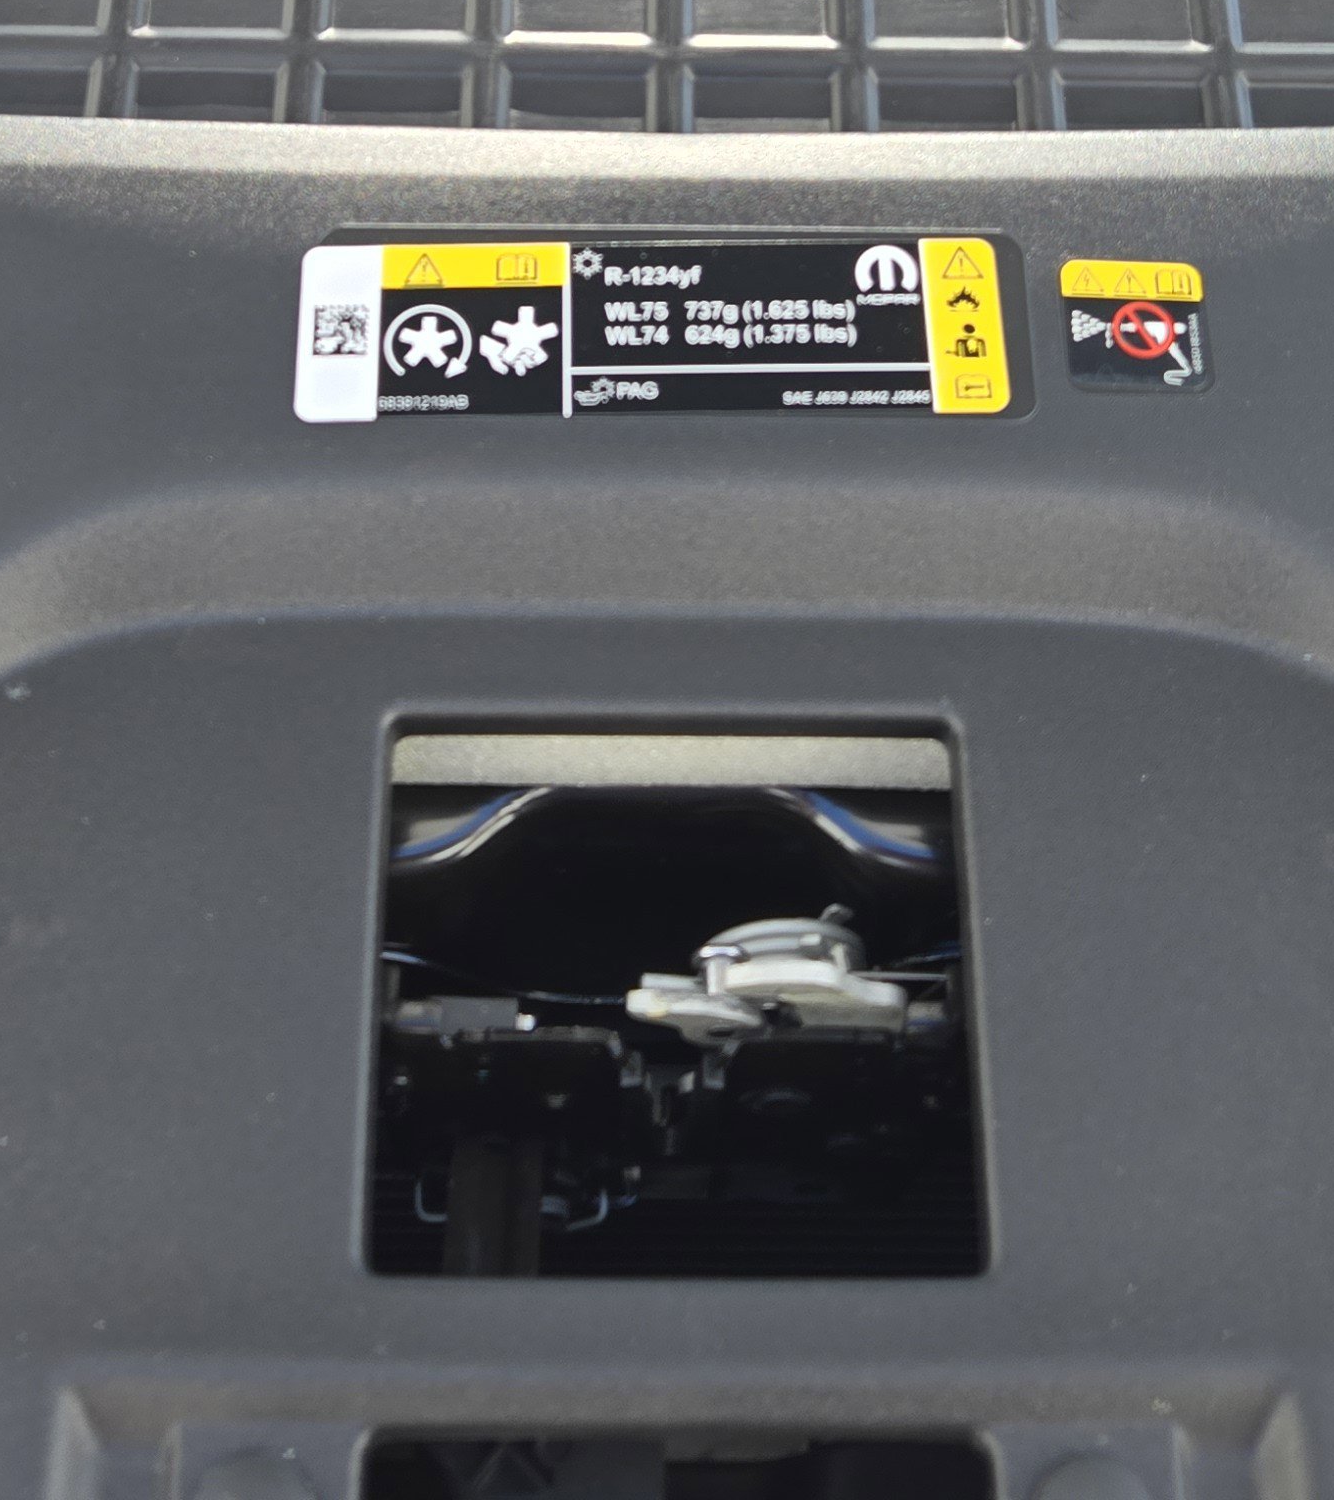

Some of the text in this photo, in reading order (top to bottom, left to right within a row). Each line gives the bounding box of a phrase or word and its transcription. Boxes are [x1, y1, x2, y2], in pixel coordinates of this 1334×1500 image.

[603, 265, 703, 290] R-1234yf
[856, 293, 921, 307] MOPAR
[604, 299, 856, 325] WL75 737g (1.625 lbs)
[604, 323, 858, 349] WL74 624g (1.375 lbs)
[616, 380, 660, 401] PAG
[782, 390, 814, 405] SAE
[815, 390, 849, 405] J639
